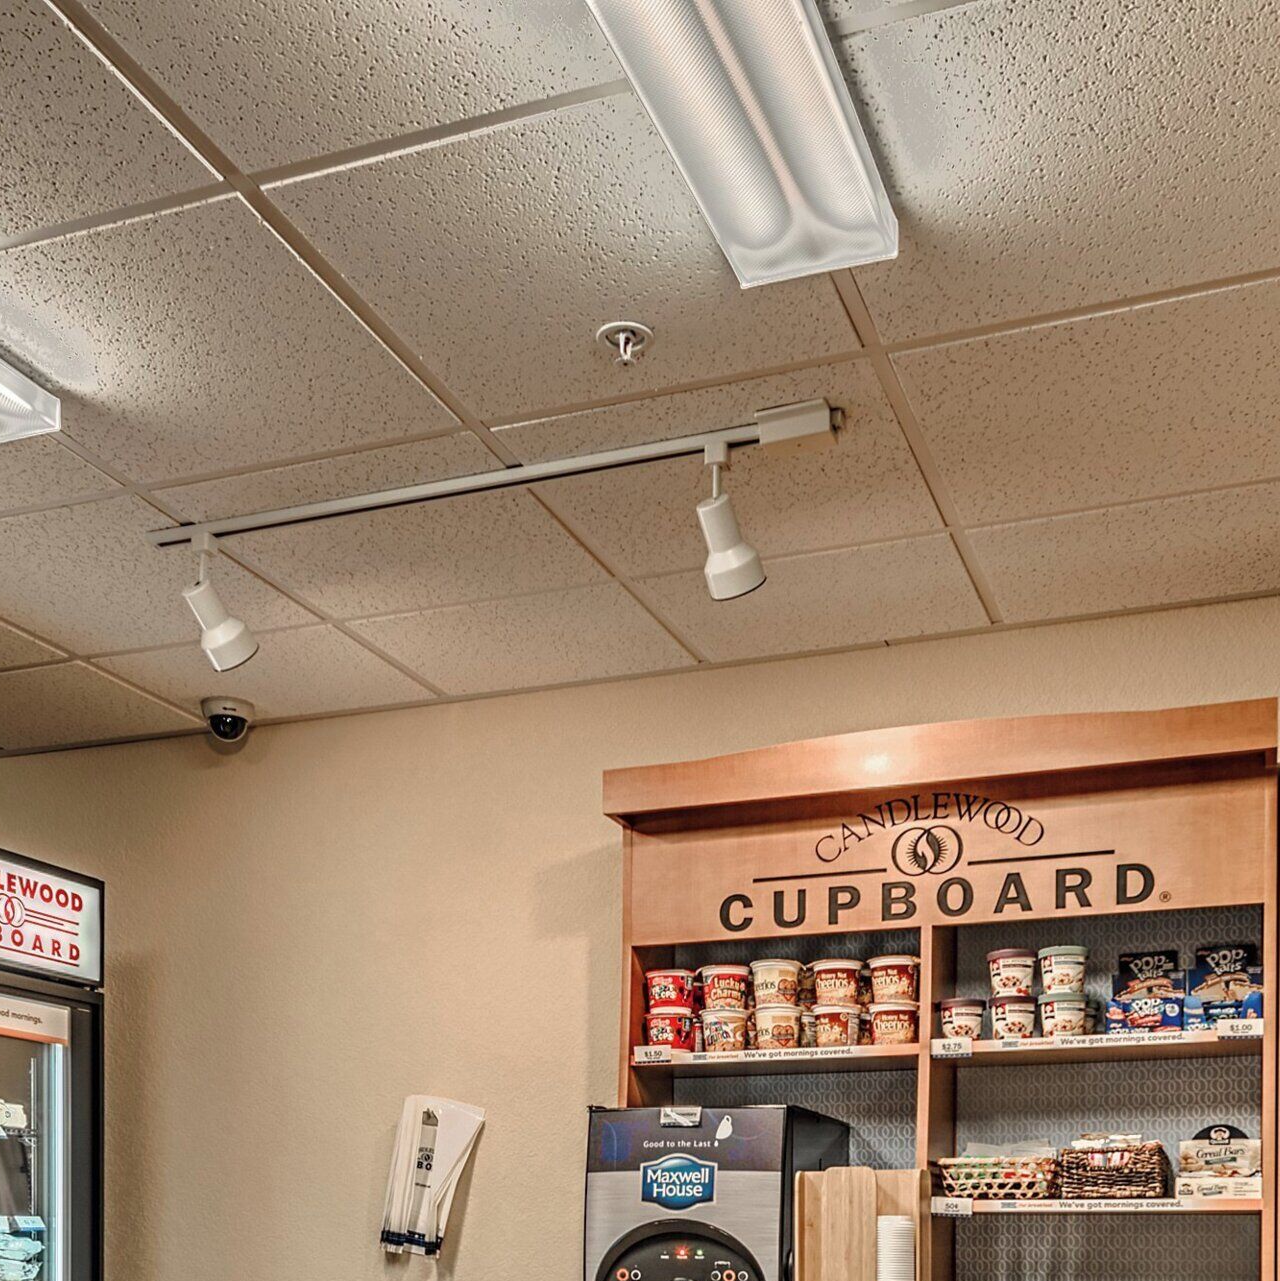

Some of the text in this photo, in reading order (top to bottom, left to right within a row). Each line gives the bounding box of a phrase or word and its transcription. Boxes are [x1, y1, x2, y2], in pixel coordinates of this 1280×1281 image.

[815, 792, 1045, 863] CANDLEWOOD
[720, 863, 1156, 932] CUPBOARD
[713, 978, 740, 989] Lucky
[872, 975, 902, 988] heerios
[11, 1011, 43, 1025] mornings.
[941, 1042, 962, 1051] $2.75
[1060, 1032, 1186, 1047] We've got mornings covered.
[744, 1046, 854, 1060] We've got mornings covered.
[643, 1140, 665, 1148] Good
[677, 1140, 692, 1148] the
[693, 1140, 711, 1148] Last
[1196, 1146, 1246, 1158] Cereal Bars
[647, 1167, 710, 1184] Maxwell
[652, 1183, 704, 1198] House
[1059, 1199, 1184, 1211] We've got mornings covered.
